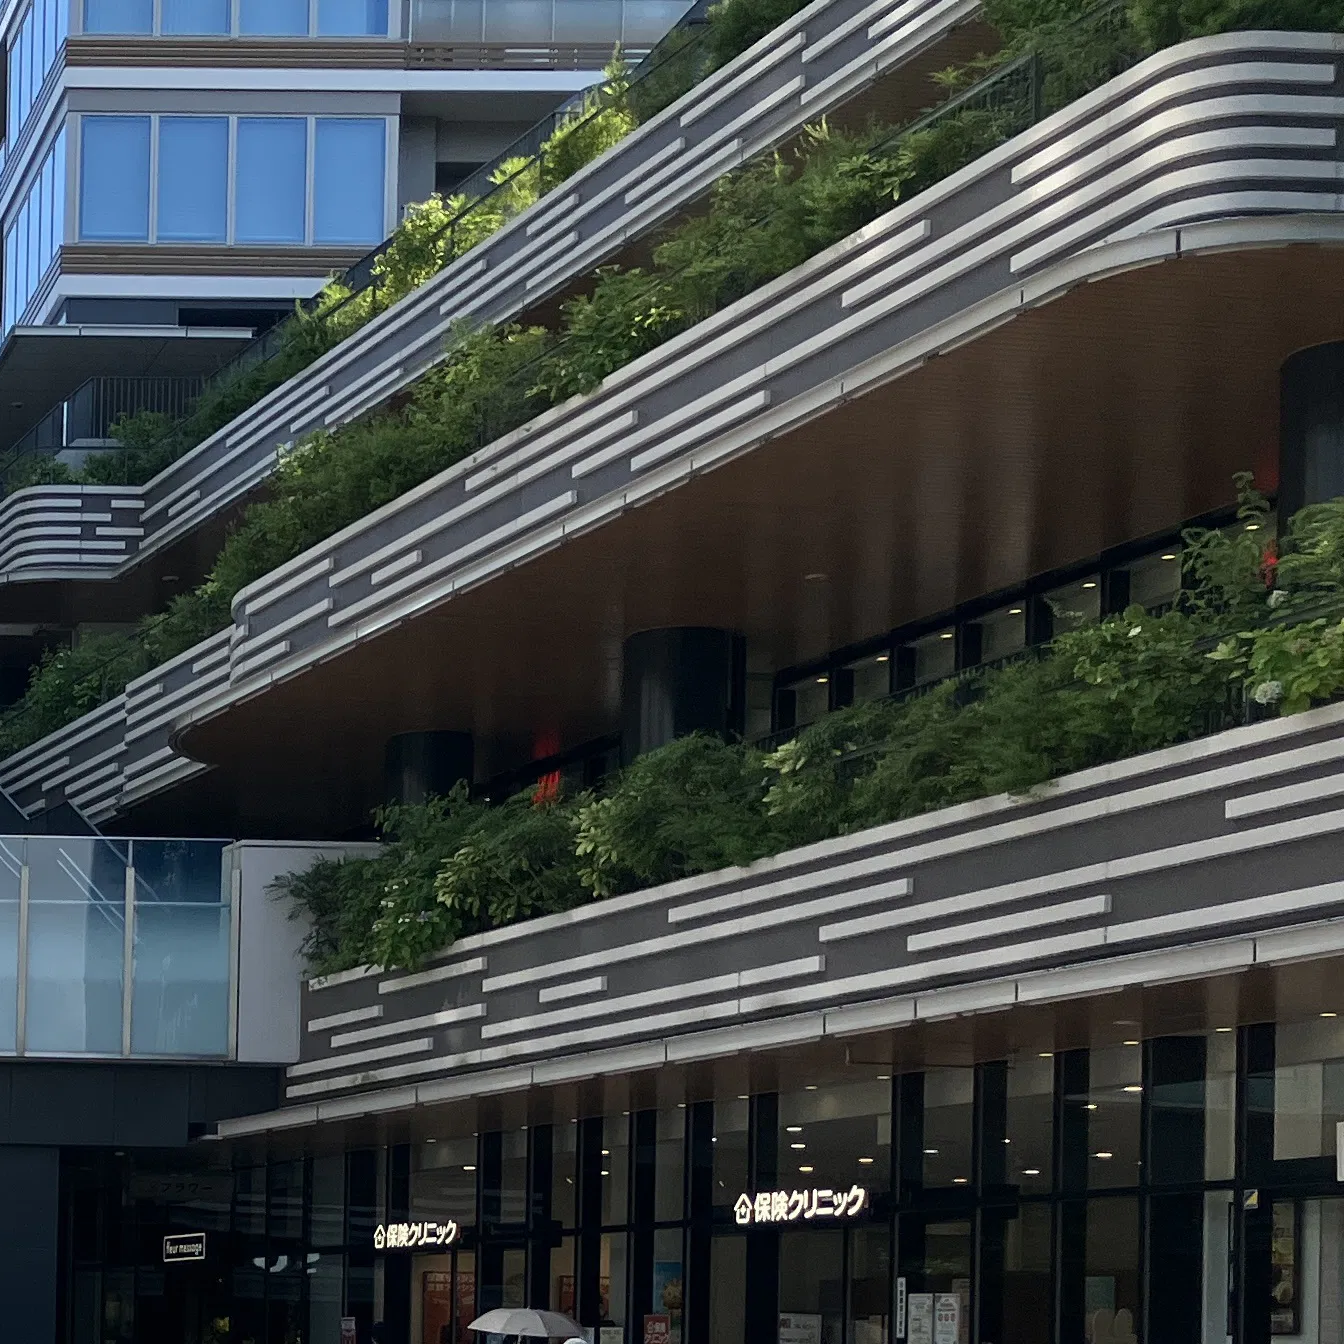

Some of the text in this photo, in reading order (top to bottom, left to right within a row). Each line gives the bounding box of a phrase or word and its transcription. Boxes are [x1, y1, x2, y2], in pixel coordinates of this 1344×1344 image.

[754, 1184, 865, 1222] 保険クリニック
[386, 1219, 457, 1248] 保険クリニック
